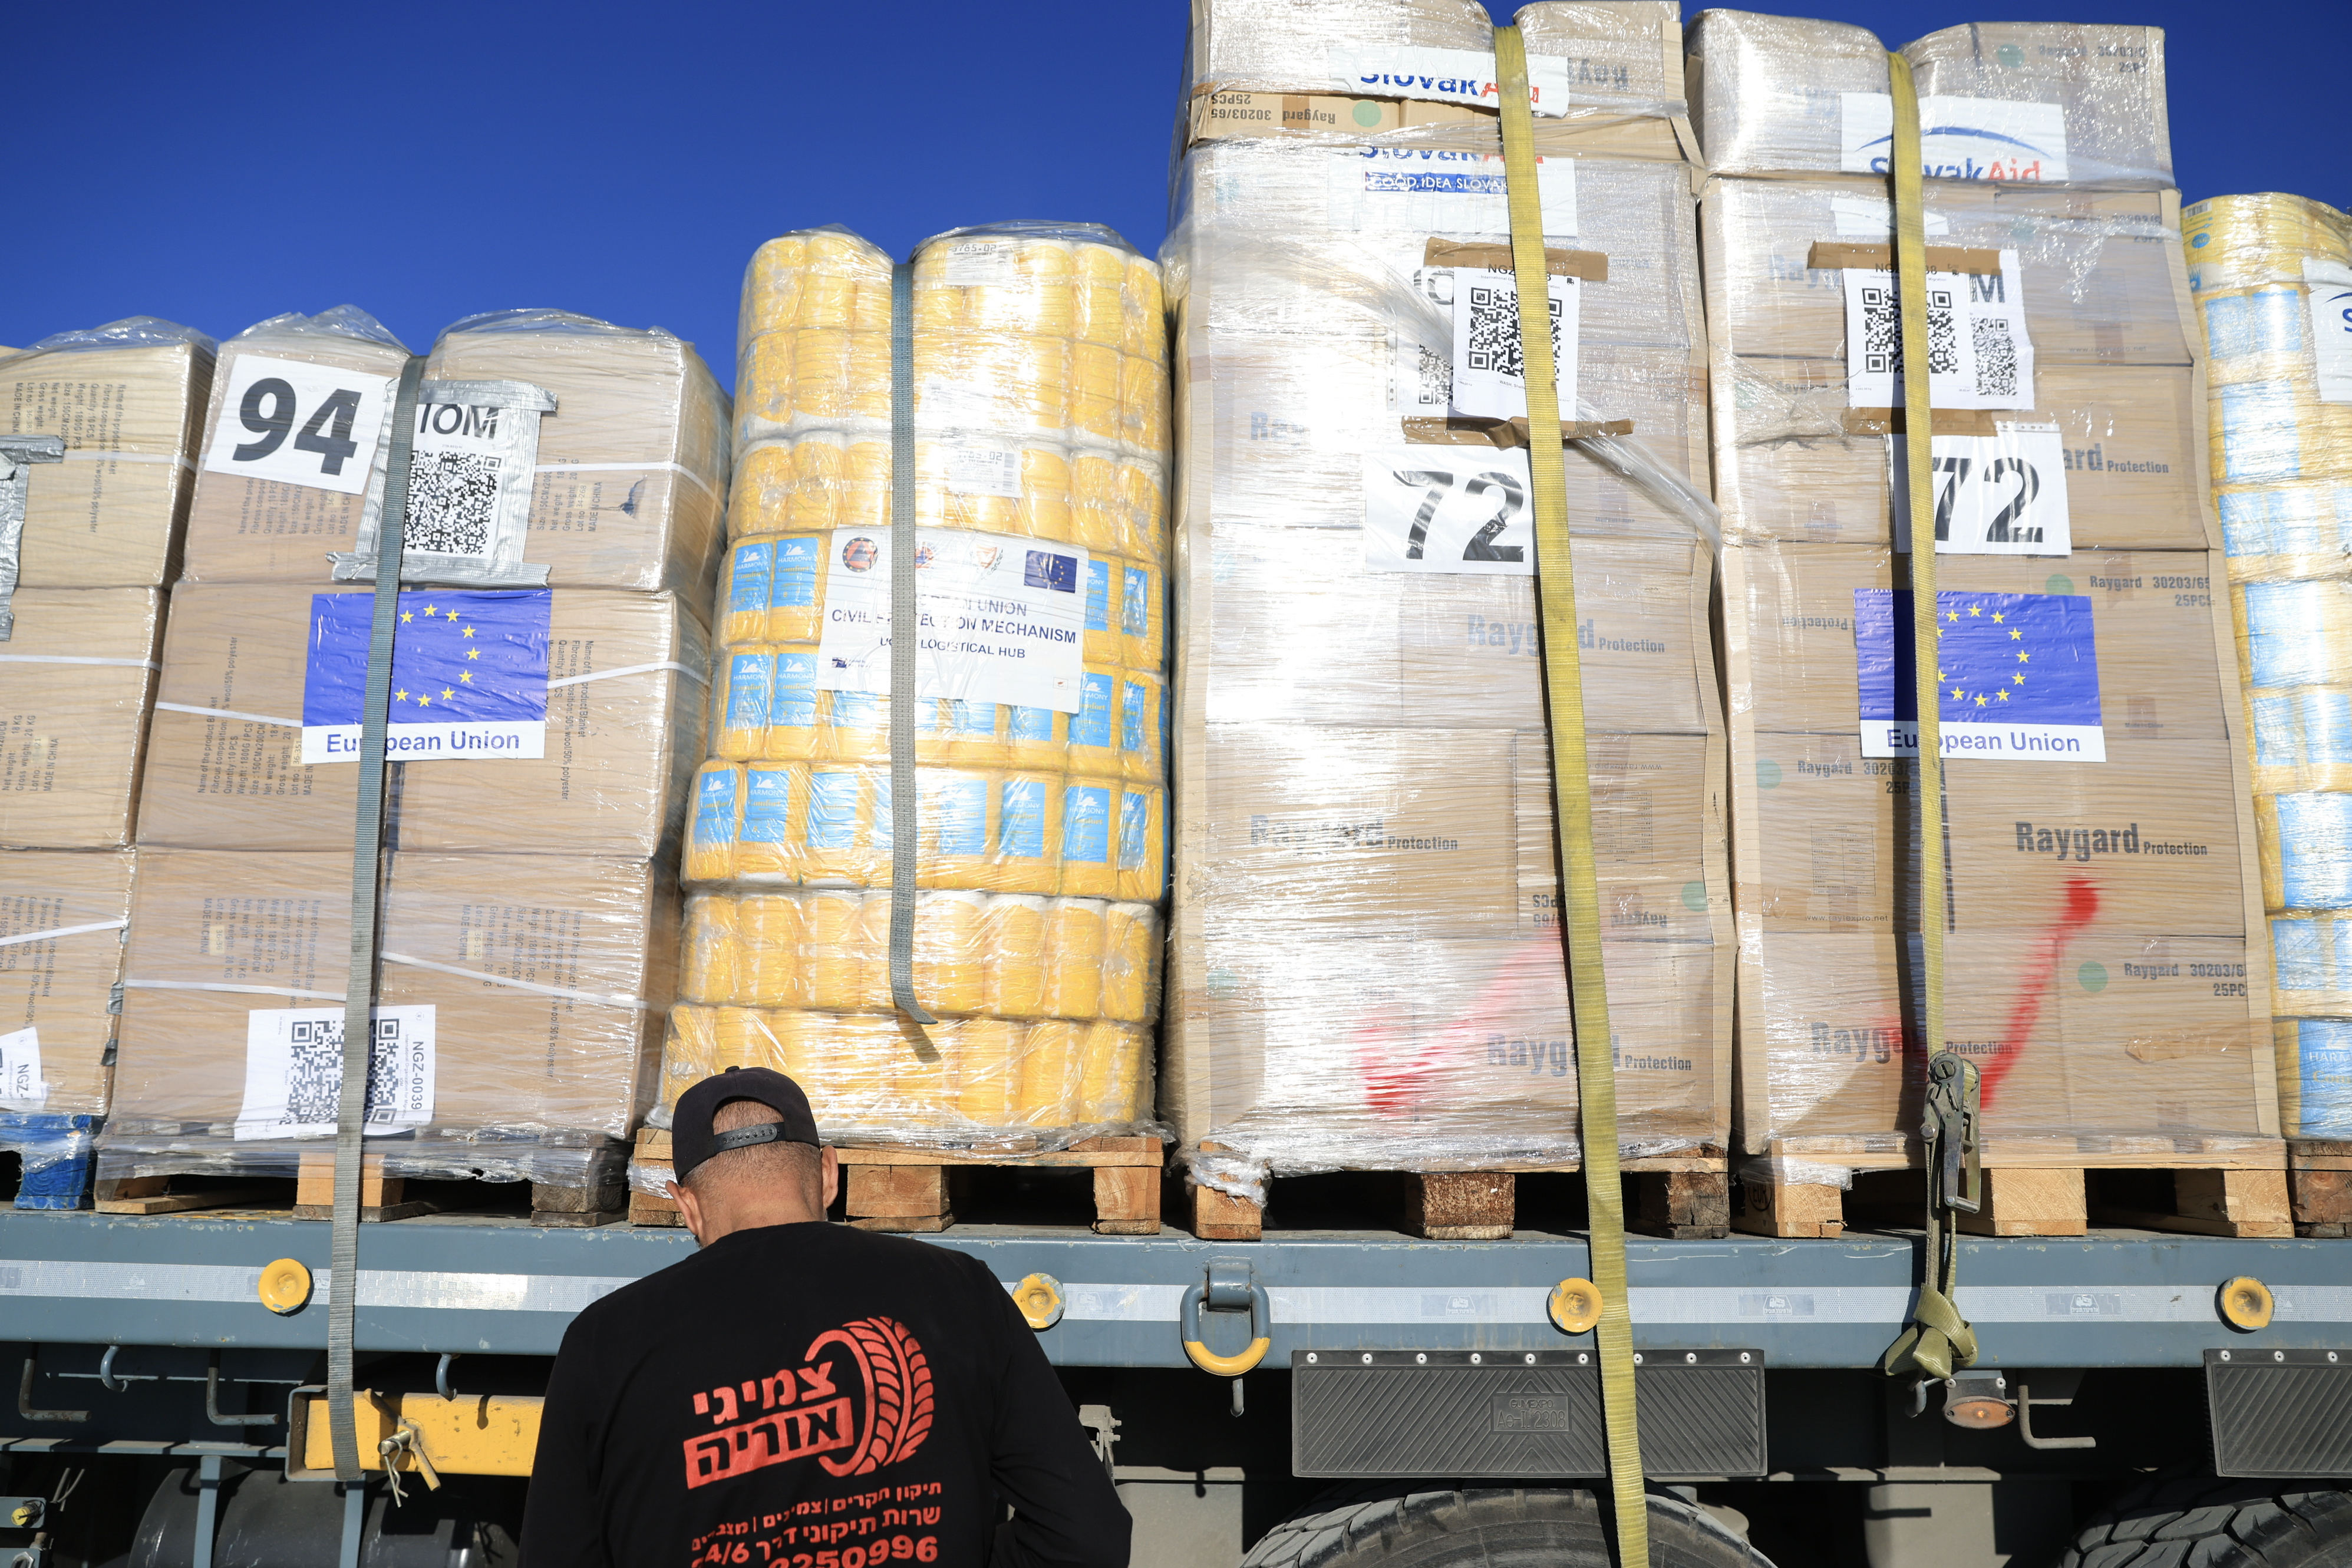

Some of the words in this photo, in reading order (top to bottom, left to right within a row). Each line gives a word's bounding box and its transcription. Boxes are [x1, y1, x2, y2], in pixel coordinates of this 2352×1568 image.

[1212, 94, 1251, 105] 25PCS
[1211, 108, 1271, 120] 30203/65
[1282, 108, 1335, 124] Raygard
[14, 383, 23, 402] MADE
[12, 412, 21, 434] CHINA
[232, 377, 361, 476] 94
[420, 403, 499, 440] IOM
[2107, 459, 2169, 474] Protection
[592, 482, 602, 503] CHINA
[1932, 457, 2043, 543] 72
[90, 502, 98, 533] polyester
[562, 511, 572, 531] Gross
[588, 512, 598, 532] MADE
[1393, 470, 1524, 563] 72
[2090, 575, 2142, 591] Raygard
[977, 599, 1027, 617] UNION
[832, 608, 871, 623] CIVIL
[982, 620, 1077, 644] MECHANISM
[1783, 616, 1848, 631] Protection
[1467, 615, 1595, 656] Raygd
[1598, 636, 1665, 653] Protection
[921, 639, 995, 655] LOGISTICAL
[998, 647, 1025, 659] HUB
[13, 715, 22, 725] KG
[210, 767, 220, 793] Fibrous
[215, 719, 227, 765] composition:
[228, 637, 237, 668] polyester
[578, 711, 588, 737] Blanket
[204, 724, 215, 751] product
[229, 735, 237, 751] PCS
[269, 729, 278, 738] 18
[327, 733, 440, 756] Eupean
[450, 730, 520, 750] Union
[1887, 729, 2001, 753] Eupean
[2011, 731, 2080, 752] Union
[15, 771, 26, 791] Gross
[27, 715, 36, 725] KG
[48, 738, 58, 760] CHINA
[202, 753, 210, 763] the
[241, 743, 249, 764] 1800G
[252, 724, 266, 774] 150CMx200CM
[279, 745, 291, 770] weight:
[265, 754, 276, 780] weight:
[1797, 760, 1852, 778] Raygard
[44, 771, 54, 791] MADE
[198, 774, 207, 793] Name
[223, 764, 236, 794] Quantity
[237, 770, 248, 794] Weight
[250, 780, 259, 795] Size
[263, 783, 272, 795] Net
[276, 774, 286, 795] Gross
[303, 775, 313, 795] MADE
[560, 767, 570, 800] polyester
[1388, 835, 1459, 851] Protection
[2015, 820, 2140, 862] Raygard
[2144, 840, 2208, 857] Protection
[203, 899, 212, 919] MADE
[461, 905, 471, 926] MADE
[540, 909, 555, 940] Quantity
[200, 930, 209, 954] CHINA
[458, 938, 469, 960] CHINA
[541, 955, 550, 969] PCS
[2124, 963, 2179, 981] Raygard
[1943, 1041, 2011, 1055] Protection
[1625, 1054, 1692, 1072] Protection
[411, 1041, 424, 1110] NGZ-0039
[692, 1361, 837, 1425] צמיגי
[1510, 1398, 1553, 1409] GUMEXPO
[1535, 1410, 1566, 1428] 2308
[697, 1408, 842, 1477] אוריה
[833, 1487, 890, 1511] תקרים
[896, 1482, 941, 1501] תיקון
[882, 1506, 941, 1527] שרות
[803, 1516, 876, 1544] תיקוני
